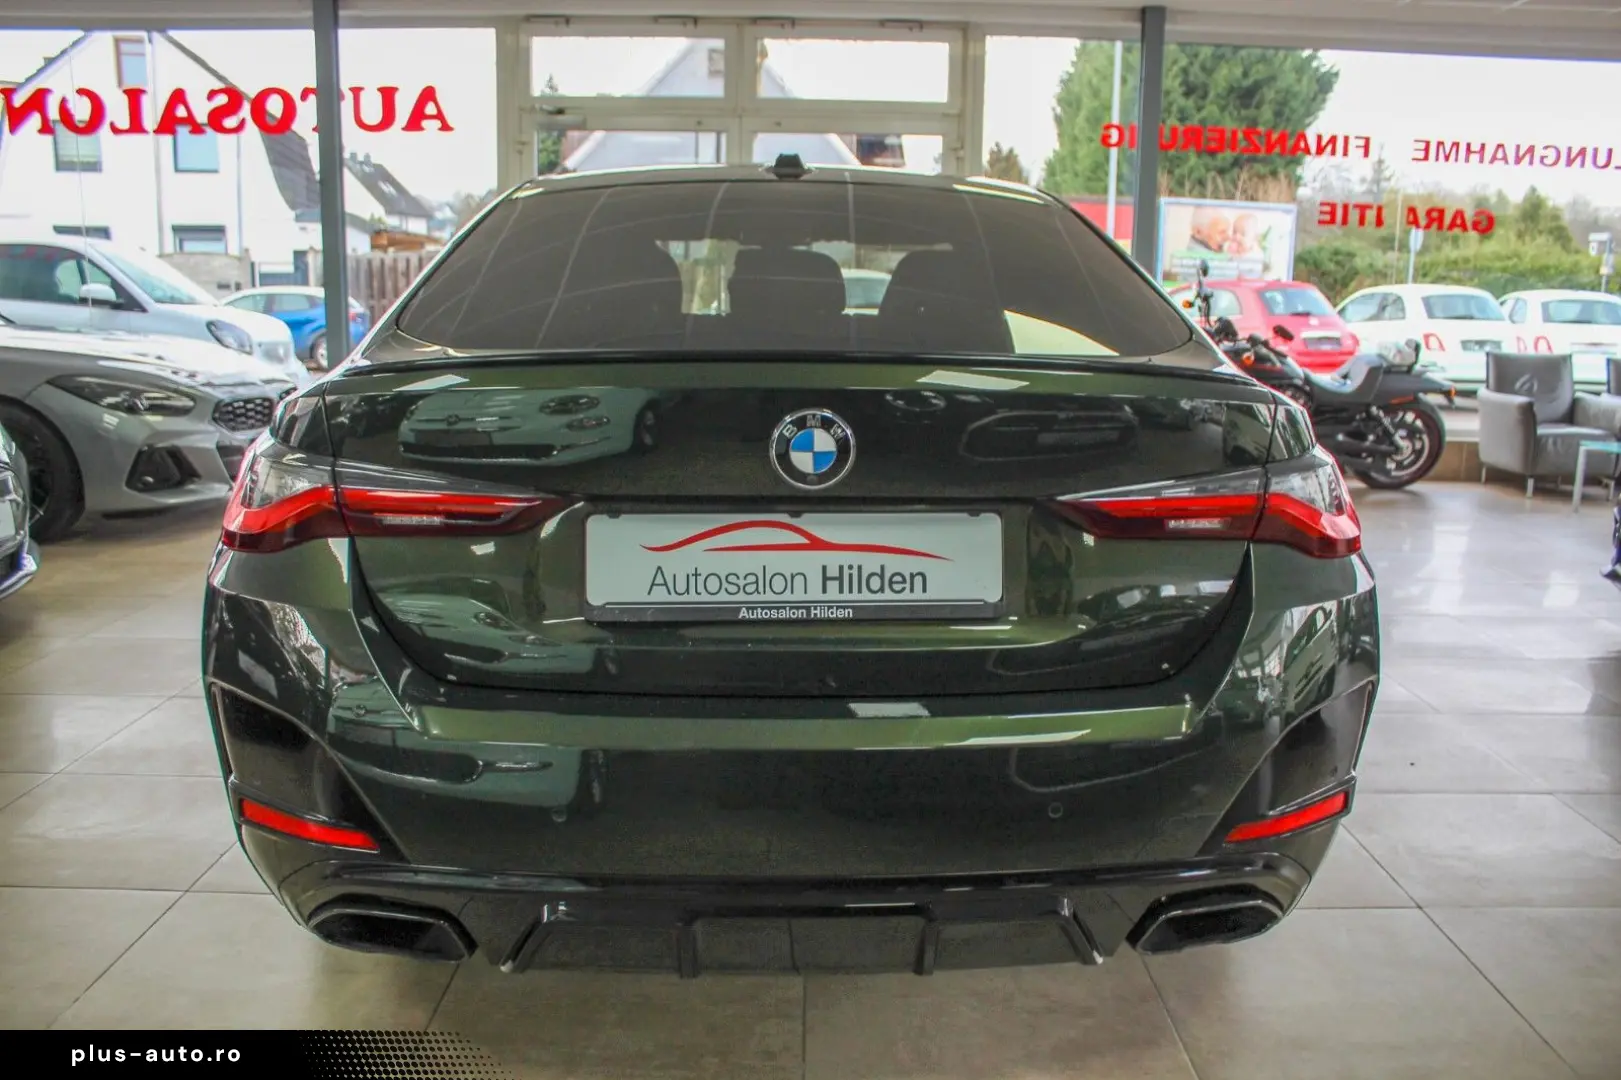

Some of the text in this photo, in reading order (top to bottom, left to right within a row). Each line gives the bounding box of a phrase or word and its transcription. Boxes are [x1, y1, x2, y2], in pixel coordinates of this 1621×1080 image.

[782, 414, 846, 441] BMW
[647, 563, 928, 596] Autosalon Hilden
[738, 606, 854, 619] Autosalon Hilden
